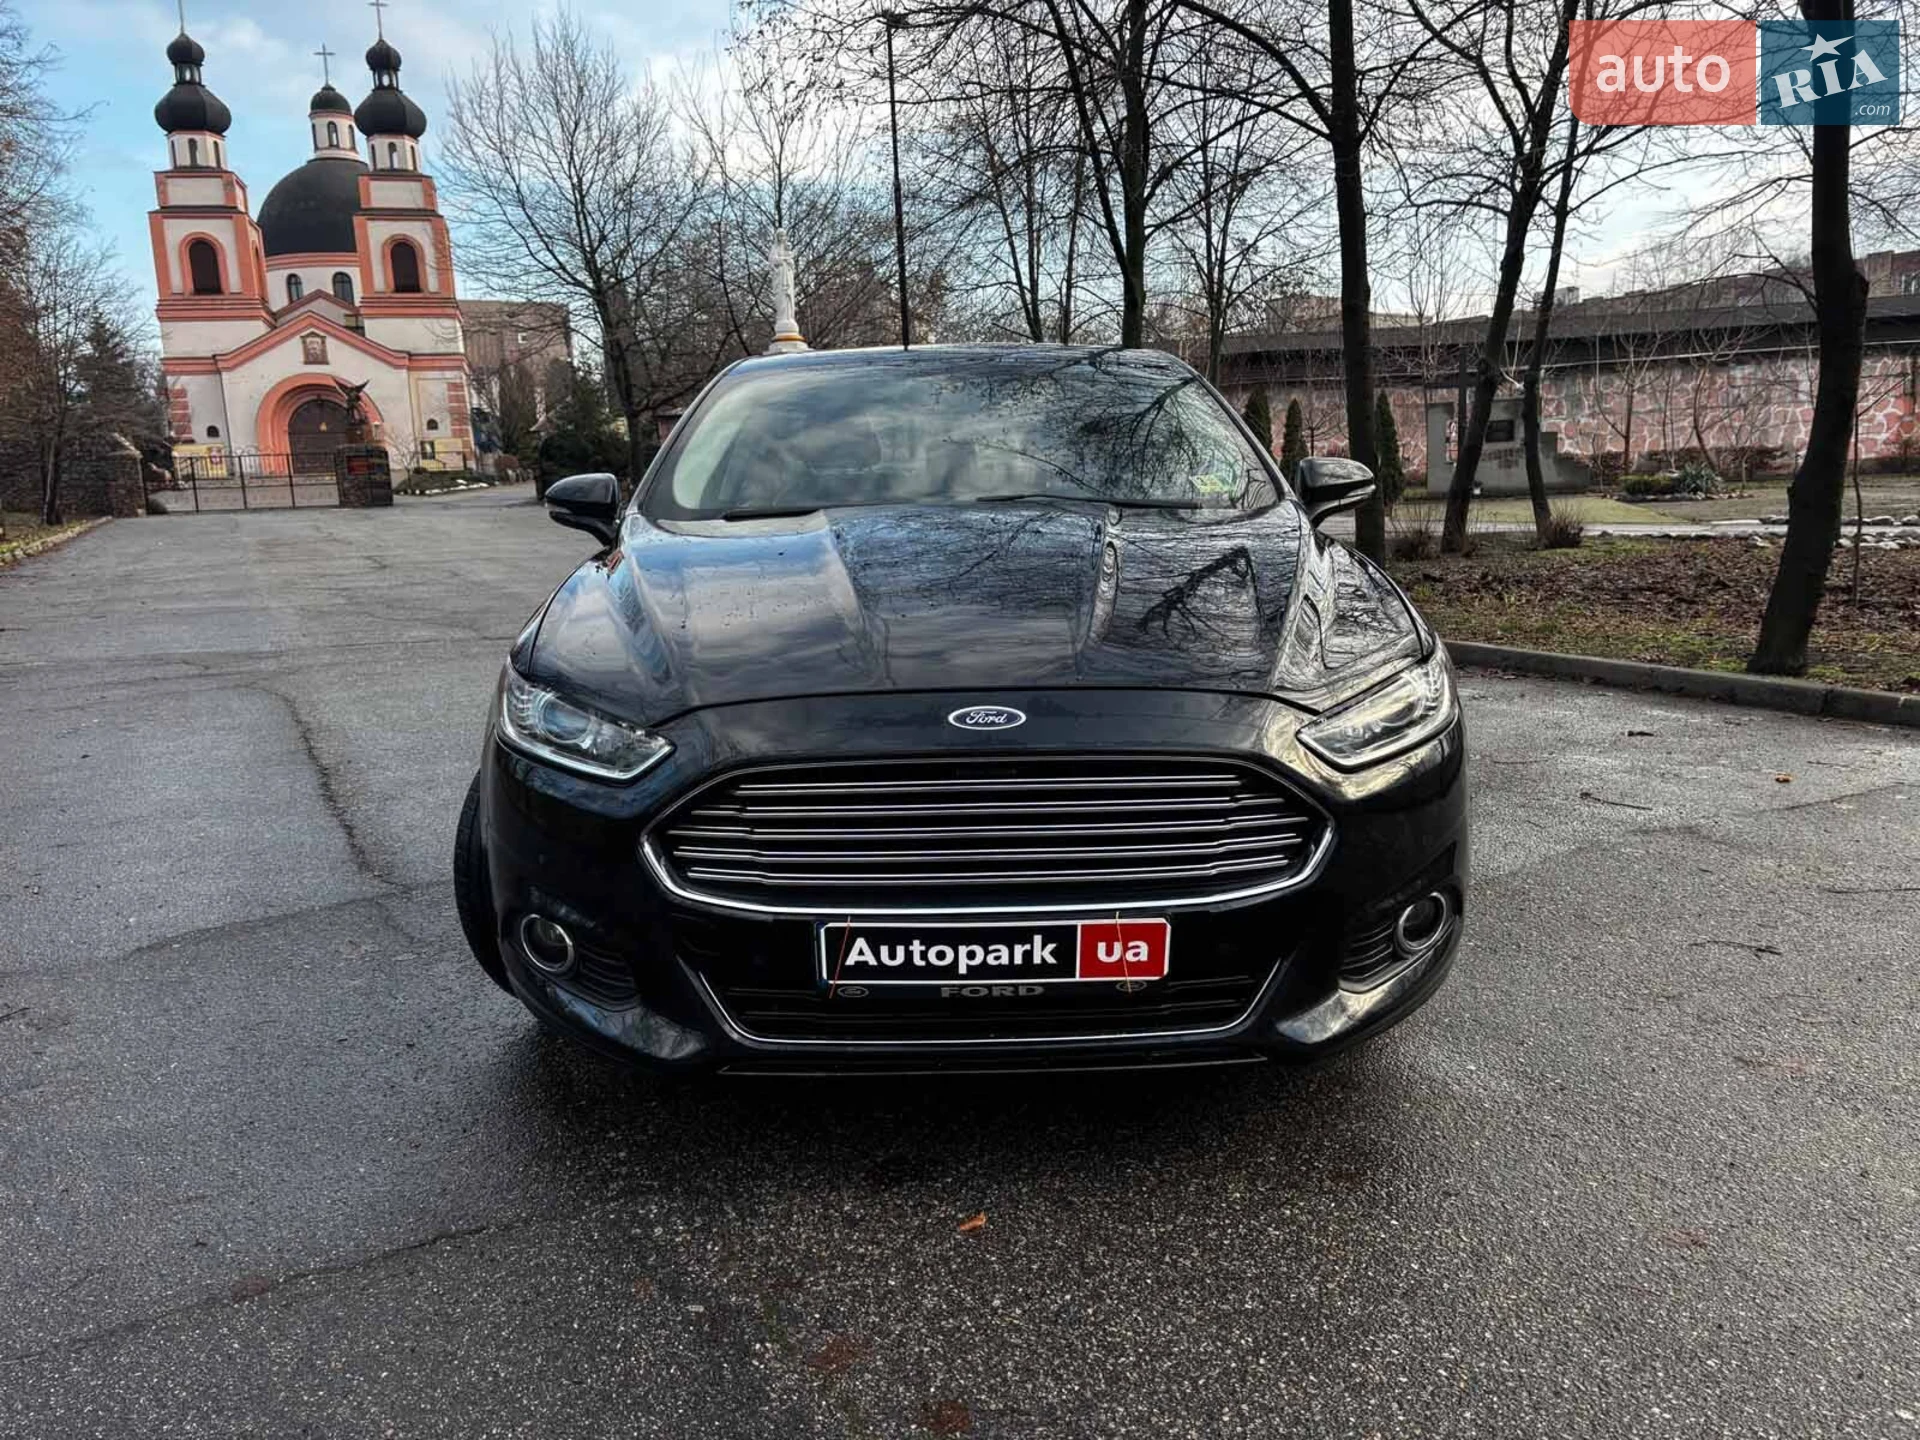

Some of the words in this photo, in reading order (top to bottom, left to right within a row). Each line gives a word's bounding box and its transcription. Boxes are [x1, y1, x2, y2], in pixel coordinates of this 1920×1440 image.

[966, 711, 1008, 724] Ford
[845, 936, 1057, 974] Autopark
[1097, 941, 1149, 963] ua
[940, 985, 1046, 998] FORD
